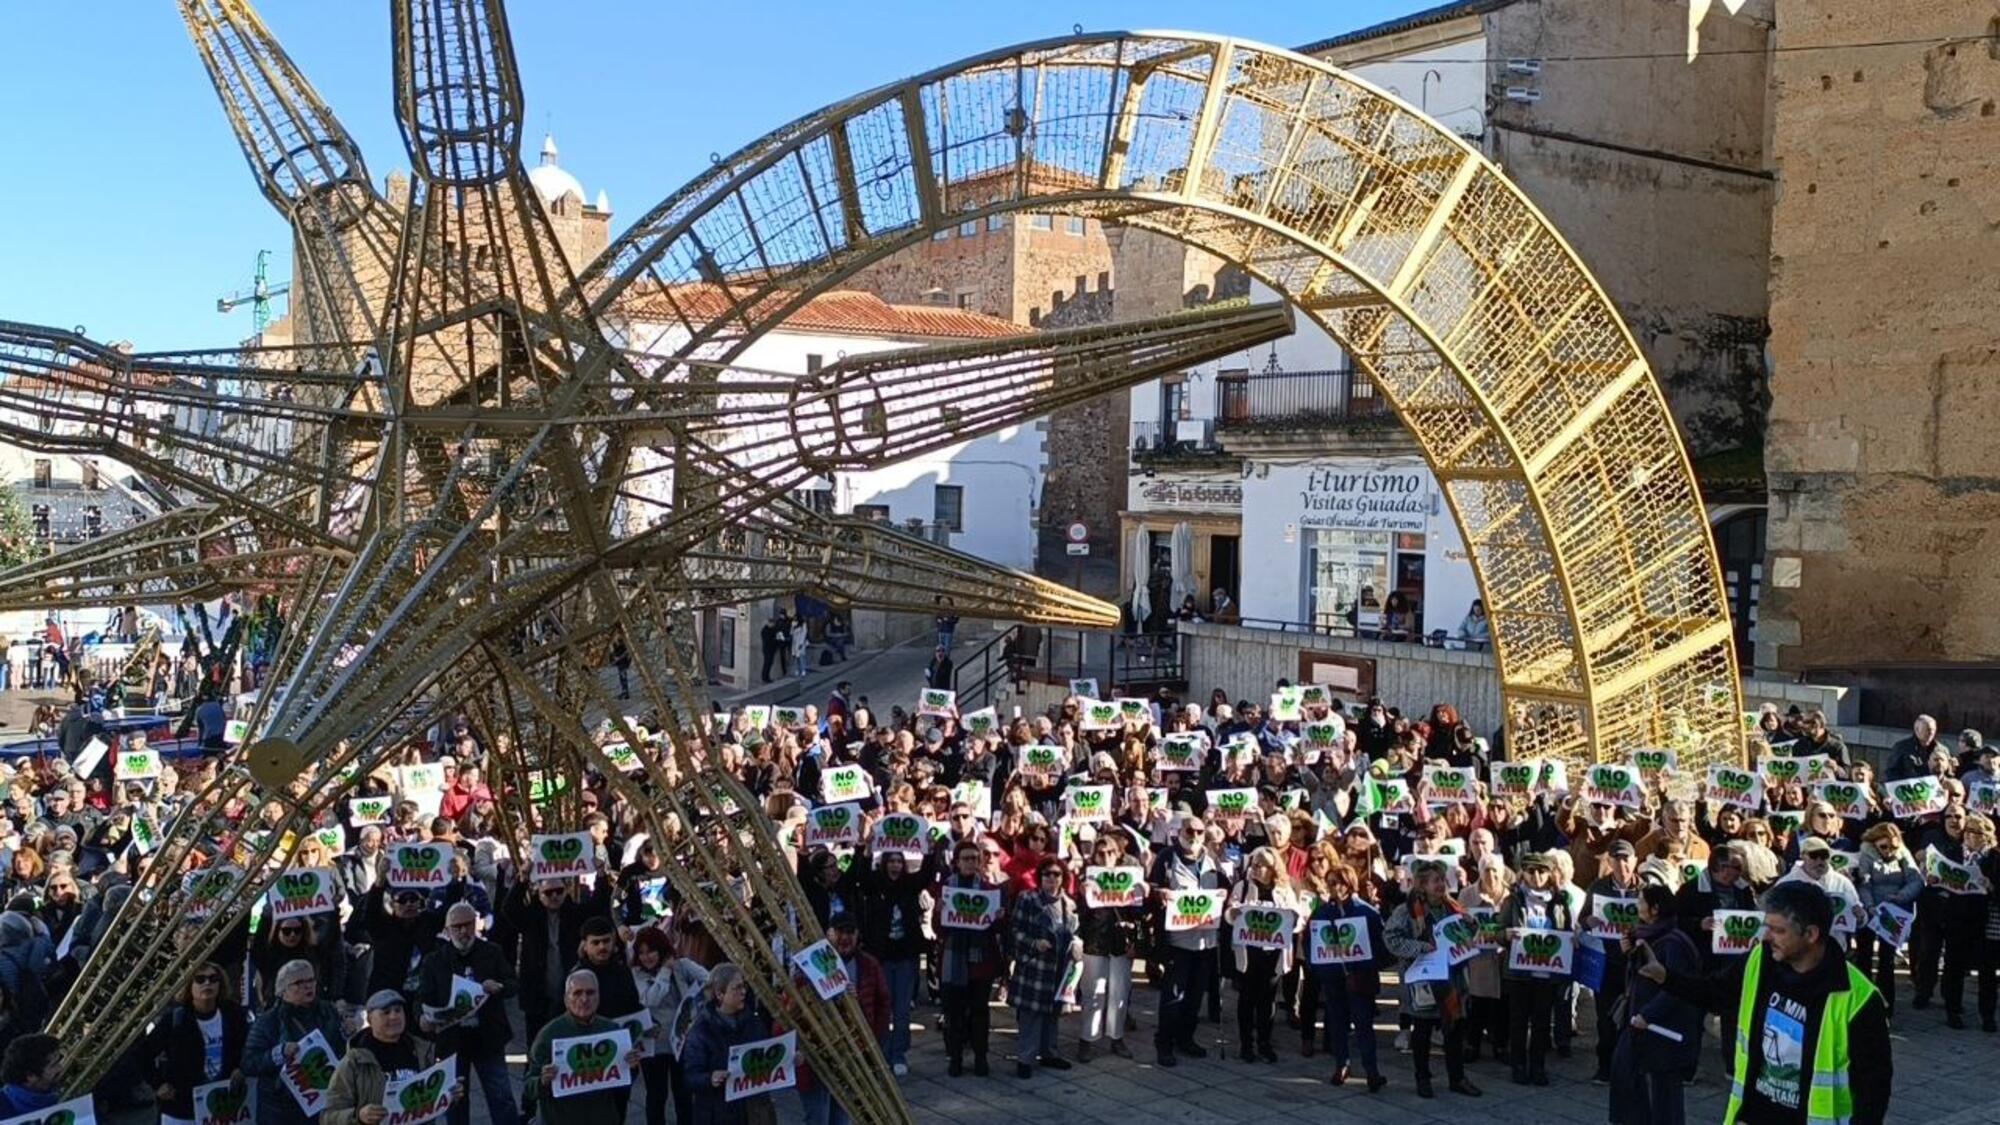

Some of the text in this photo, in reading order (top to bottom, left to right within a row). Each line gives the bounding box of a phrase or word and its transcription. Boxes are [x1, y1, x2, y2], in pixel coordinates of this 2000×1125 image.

[1308, 471, 1419, 493] i-turismo
[1300, 491, 1423, 515] Visitas Guiadas
[1380, 517, 1422, 530] Turismo
[929, 691, 946, 700] NO
[1095, 705, 1111, 713] NO
[1122, 701, 1140, 709] NO
[779, 710, 796, 719] NO
[972, 716, 990, 724] NO
[1312, 725, 1330, 733] NO
[1170, 741, 1189, 750] NO
[1304, 739, 1338, 749] MINA
[615, 746, 630, 756] NO
[1032, 749, 1050, 758] NO
[1640, 751, 1662, 761] NO
[130, 754, 147, 763] NO
[1507, 766, 1529, 777] NO
[1772, 760, 1795, 771] NO
[835, 770, 855, 781] NO
[1438, 771, 1461, 781] NO
[1600, 769, 1625, 782] NO
[1725, 770, 1749, 784] NO
[1081, 790, 1100, 802] NO
[1222, 791, 1243, 801] NO
[1429, 787, 1468, 799] MINA
[1588, 787, 1633, 802] MINA
[1709, 786, 1753, 804] MINA
[1830, 785, 1854, 797] NO
[1901, 783, 1924, 797] NO
[361, 801, 380, 810] NO
[822, 807, 847, 821] NO
[890, 817, 913, 830] NO
[811, 826, 852, 841] MINA
[551, 838, 576, 852] NO
[877, 837, 921, 850] MINA
[406, 847, 434, 860] NO
[537, 858, 587, 874] MINA
[284, 873, 312, 888] NO
[391, 869, 443, 882] MINA
[1104, 872, 1127, 884] NO
[960, 894, 983, 906] NO
[1093, 890, 1135, 903] MINA
[1184, 895, 1207, 907] NO
[275, 894, 328, 914] MINA
[1611, 902, 1637, 915] NO
[948, 911, 993, 925] MINA
[1172, 914, 1214, 926] MINA
[1253, 911, 1277, 923] NO
[1731, 916, 1755, 929] NO
[1239, 929, 1285, 946] MINA
[1530, 934, 1555, 947] NO
[1317, 944, 1364, 959] MINA
[1516, 953, 1563, 969] MINA
[576, 1039, 609, 1059] NO
[752, 1044, 781, 1062] NO
[410, 1071, 440, 1096] NO
[560, 1065, 620, 1090] MINA
[733, 1067, 787, 1092] MINA
[388, 1094, 449, 1125] MINA
